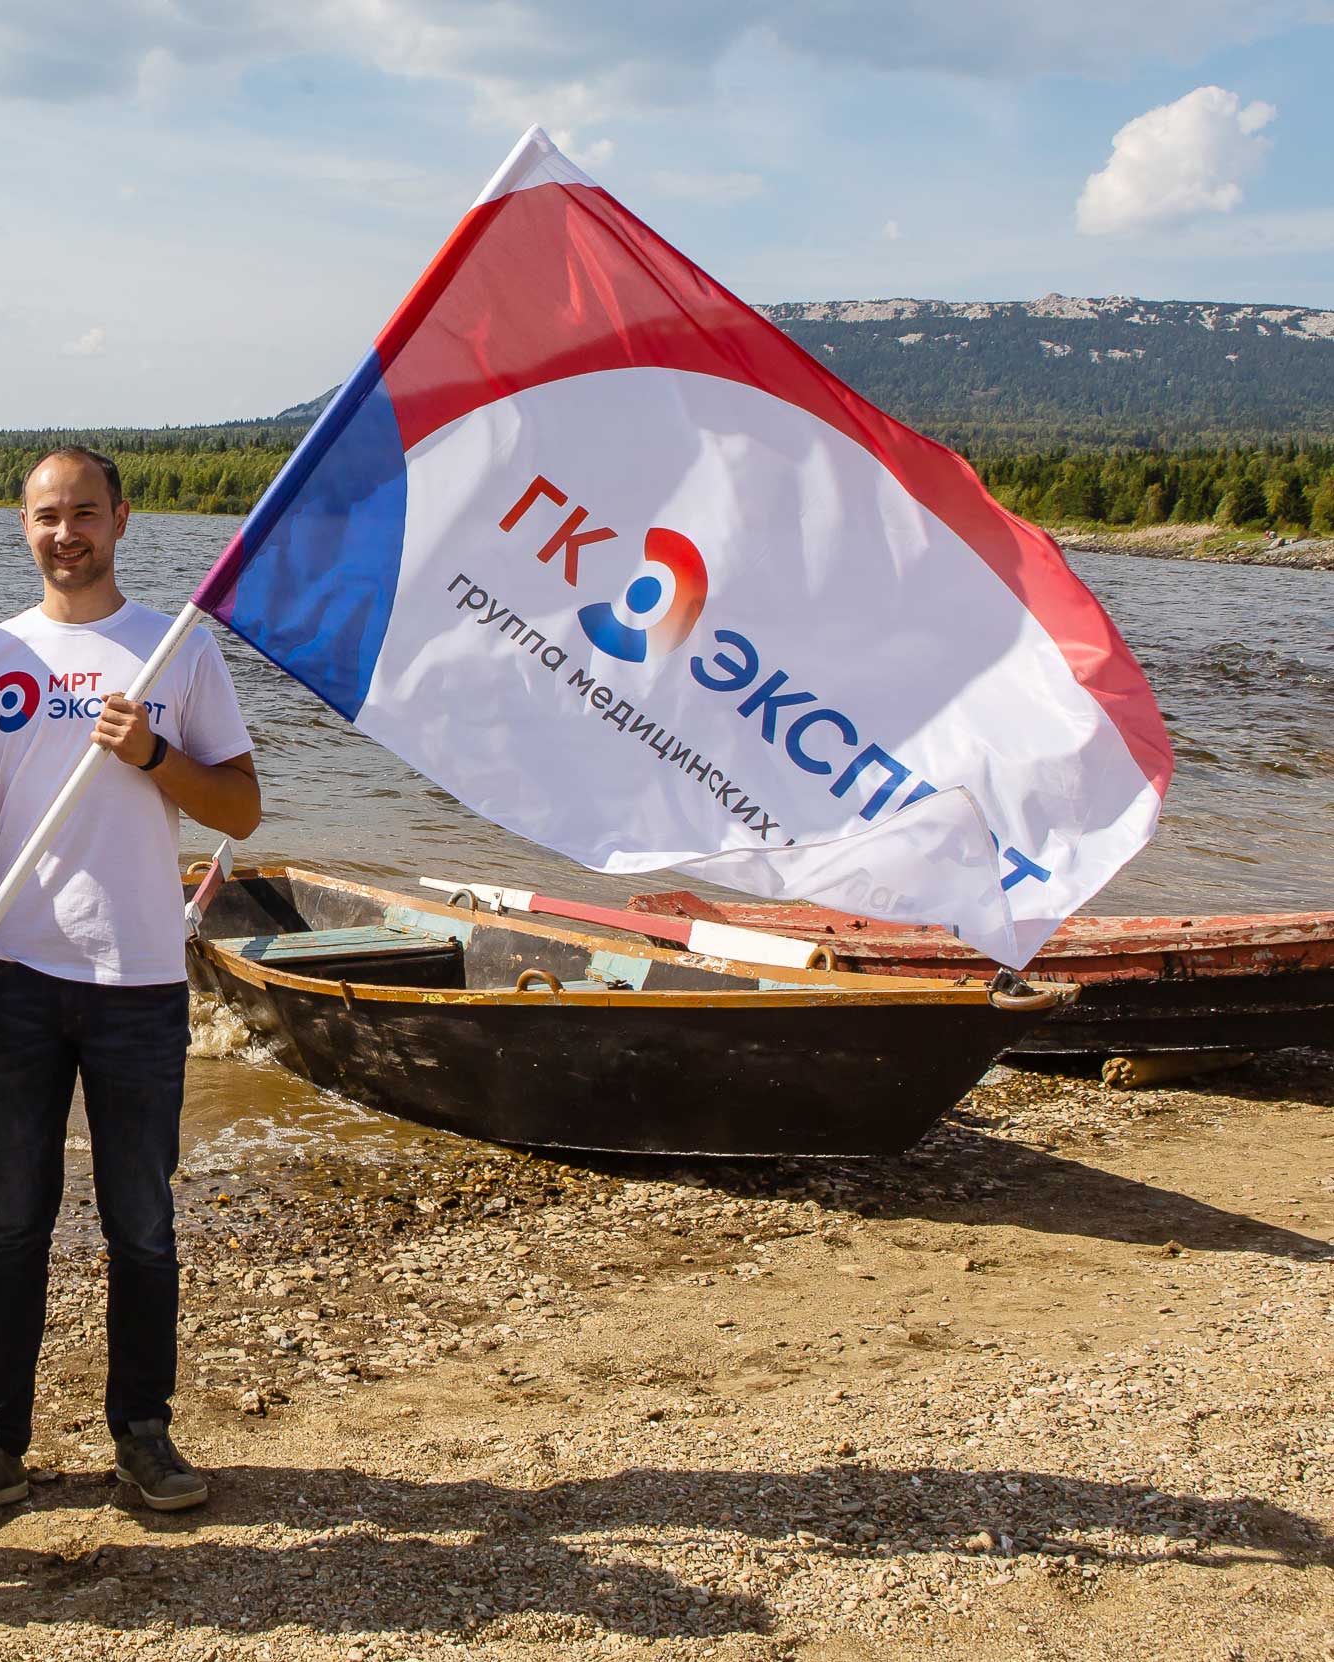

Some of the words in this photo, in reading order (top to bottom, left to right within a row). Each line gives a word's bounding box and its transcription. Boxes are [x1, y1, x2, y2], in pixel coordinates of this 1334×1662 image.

[498, 474, 618, 587] ГК
[48, 672, 102, 693] МРТ
[446, 572, 568, 672] группа
[566, 664, 781, 843] медицинских
